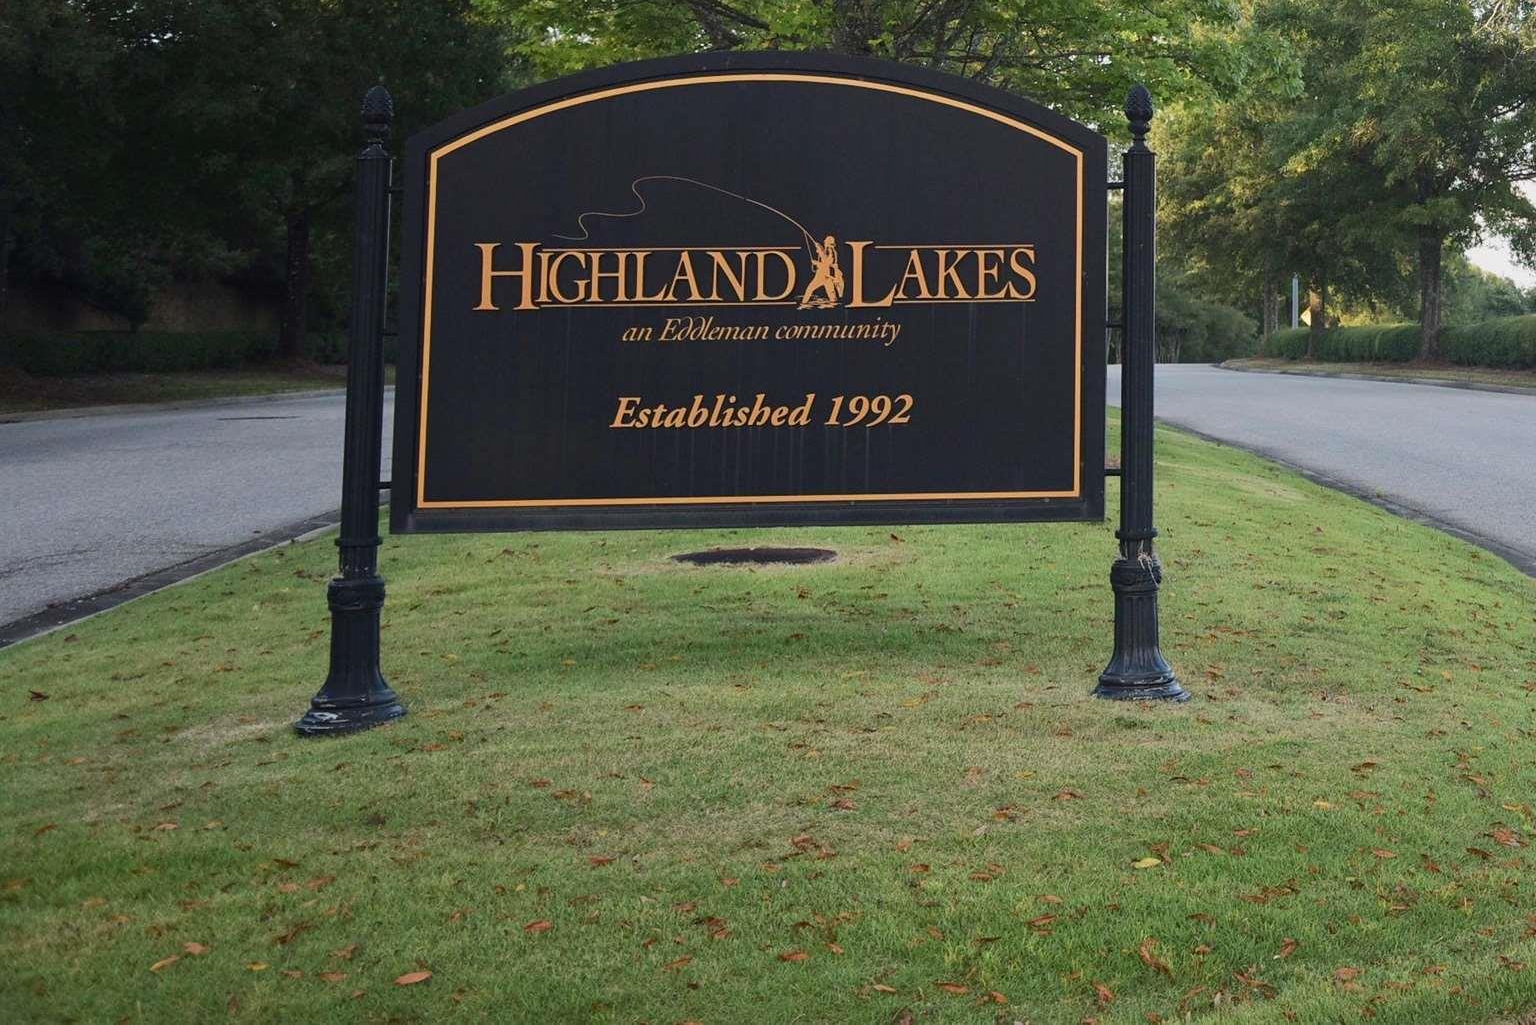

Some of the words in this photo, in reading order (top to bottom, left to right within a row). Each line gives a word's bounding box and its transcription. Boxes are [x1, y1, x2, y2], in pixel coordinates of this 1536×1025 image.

[472, 242, 797, 311] HIGHLAND
[844, 240, 1037, 309] LAKES
[622, 325, 653, 344] an
[659, 316, 769, 343] Eddleman
[774, 316, 901, 346] community
[609, 394, 815, 429] Established
[824, 393, 914, 427] 1992
